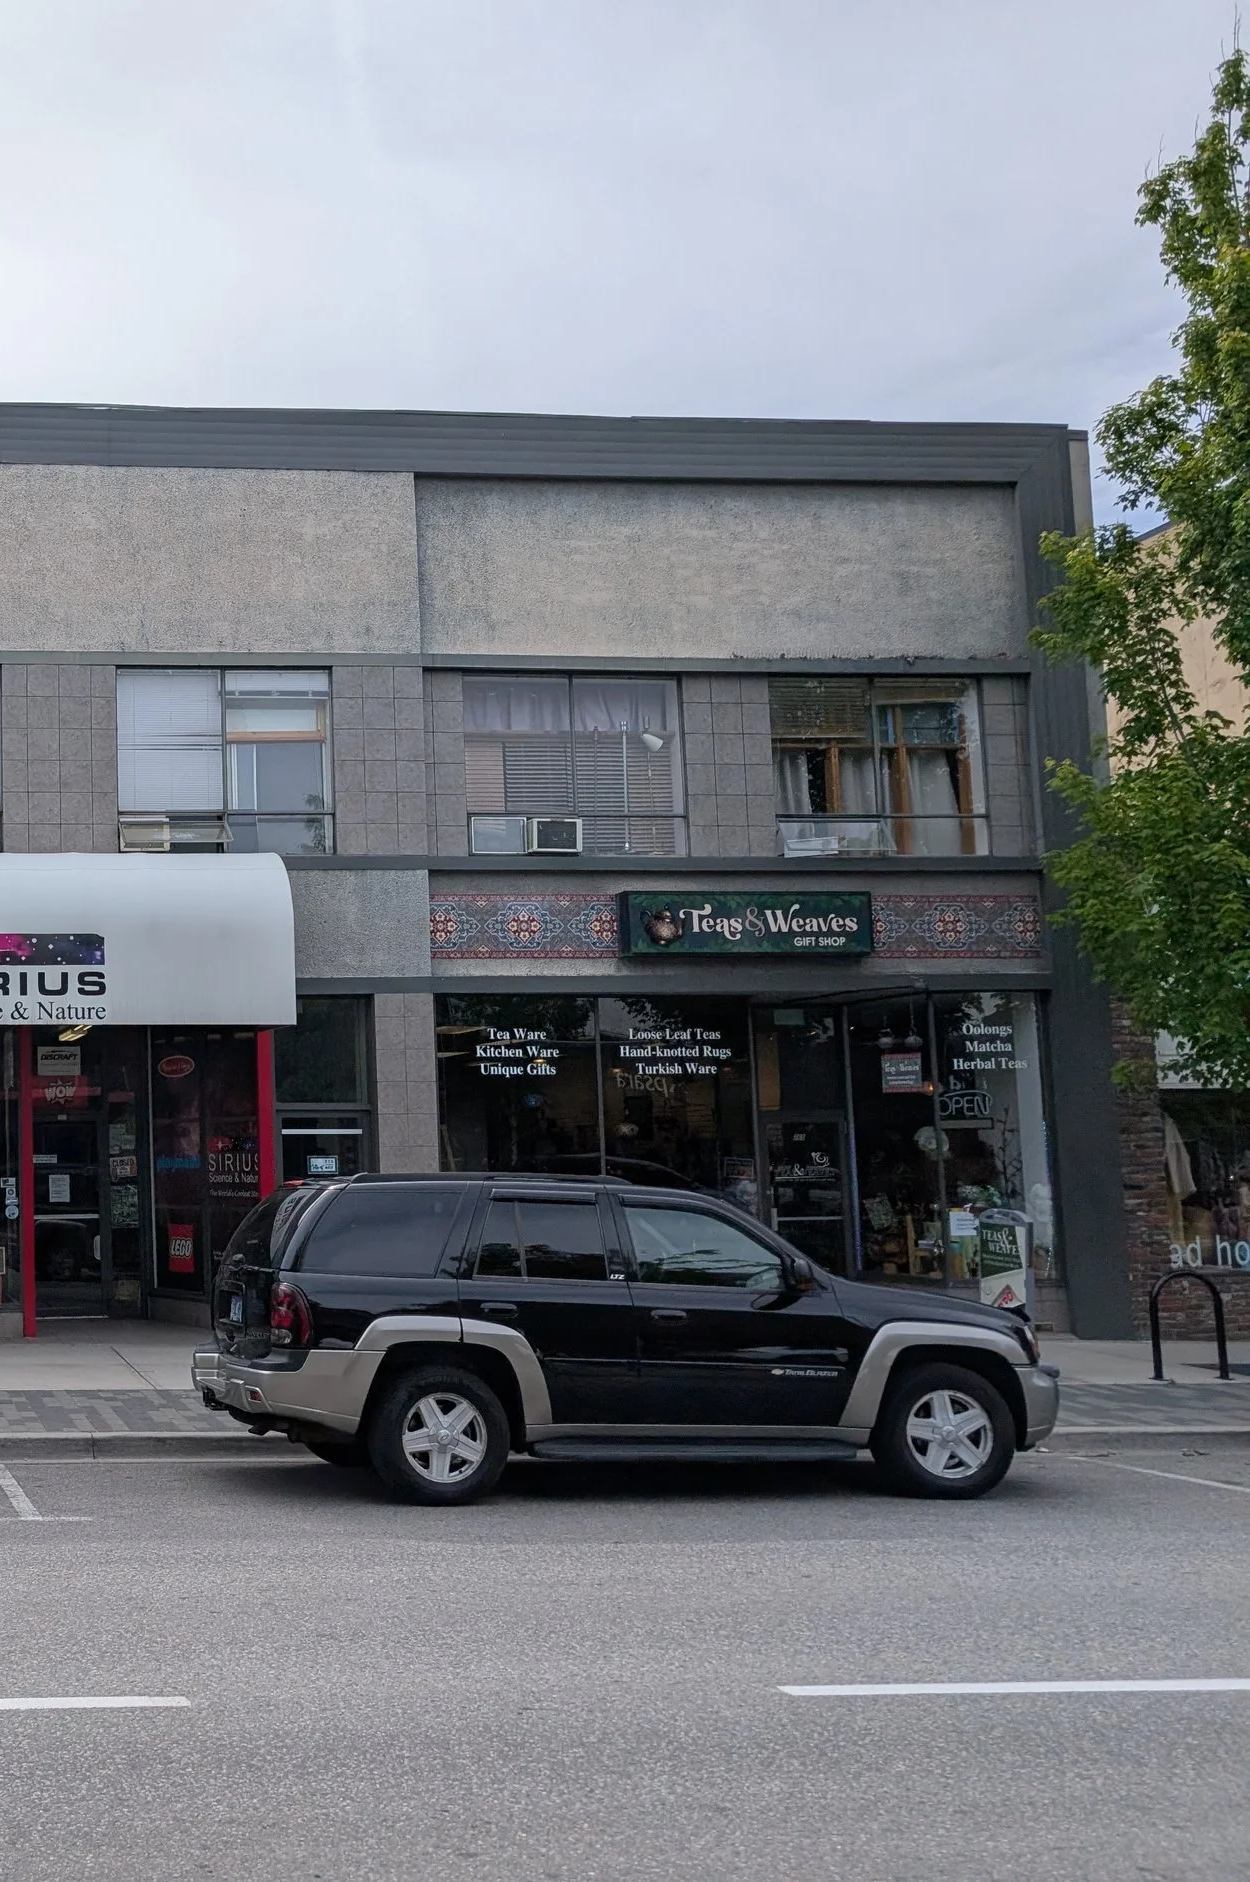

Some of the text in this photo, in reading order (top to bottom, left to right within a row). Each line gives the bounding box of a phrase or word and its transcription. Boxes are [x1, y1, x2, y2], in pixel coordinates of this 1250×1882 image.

[679, 903, 858, 940] Teas & Weaves
[794, 936, 846, 947] GIFT SHOP
[10, 1001, 30, 1020] &
[37, 1001, 107, 1020] Nature
[487, 1028, 547, 1040] Tea Ware
[628, 1028, 721, 1040] Loose Leaf Teas
[962, 1023, 1013, 1037] Oolongs
[475, 1046, 560, 1058] Kitchen Ware
[619, 1046, 731, 1059] Hand-knotted Rugs
[965, 1041, 1012, 1052] Matcha
[40, 1053, 78, 1061] DISCRAFT
[635, 1063, 718, 1075] Turkish Ware
[953, 1058, 1028, 1070] Herbal Teas
[480, 1063, 557, 1078] Unique Gifts
[44, 1084, 77, 1101] WOW
[937, 1096, 990, 1116] OPEN
[208, 1172, 233, 1183] Science
[234, 1172, 240, 1183] &
[982, 1229, 1002, 1240] TEAS
[170, 1237, 192, 1257] LEGO
[1169, 1235, 1203, 1267] ad
